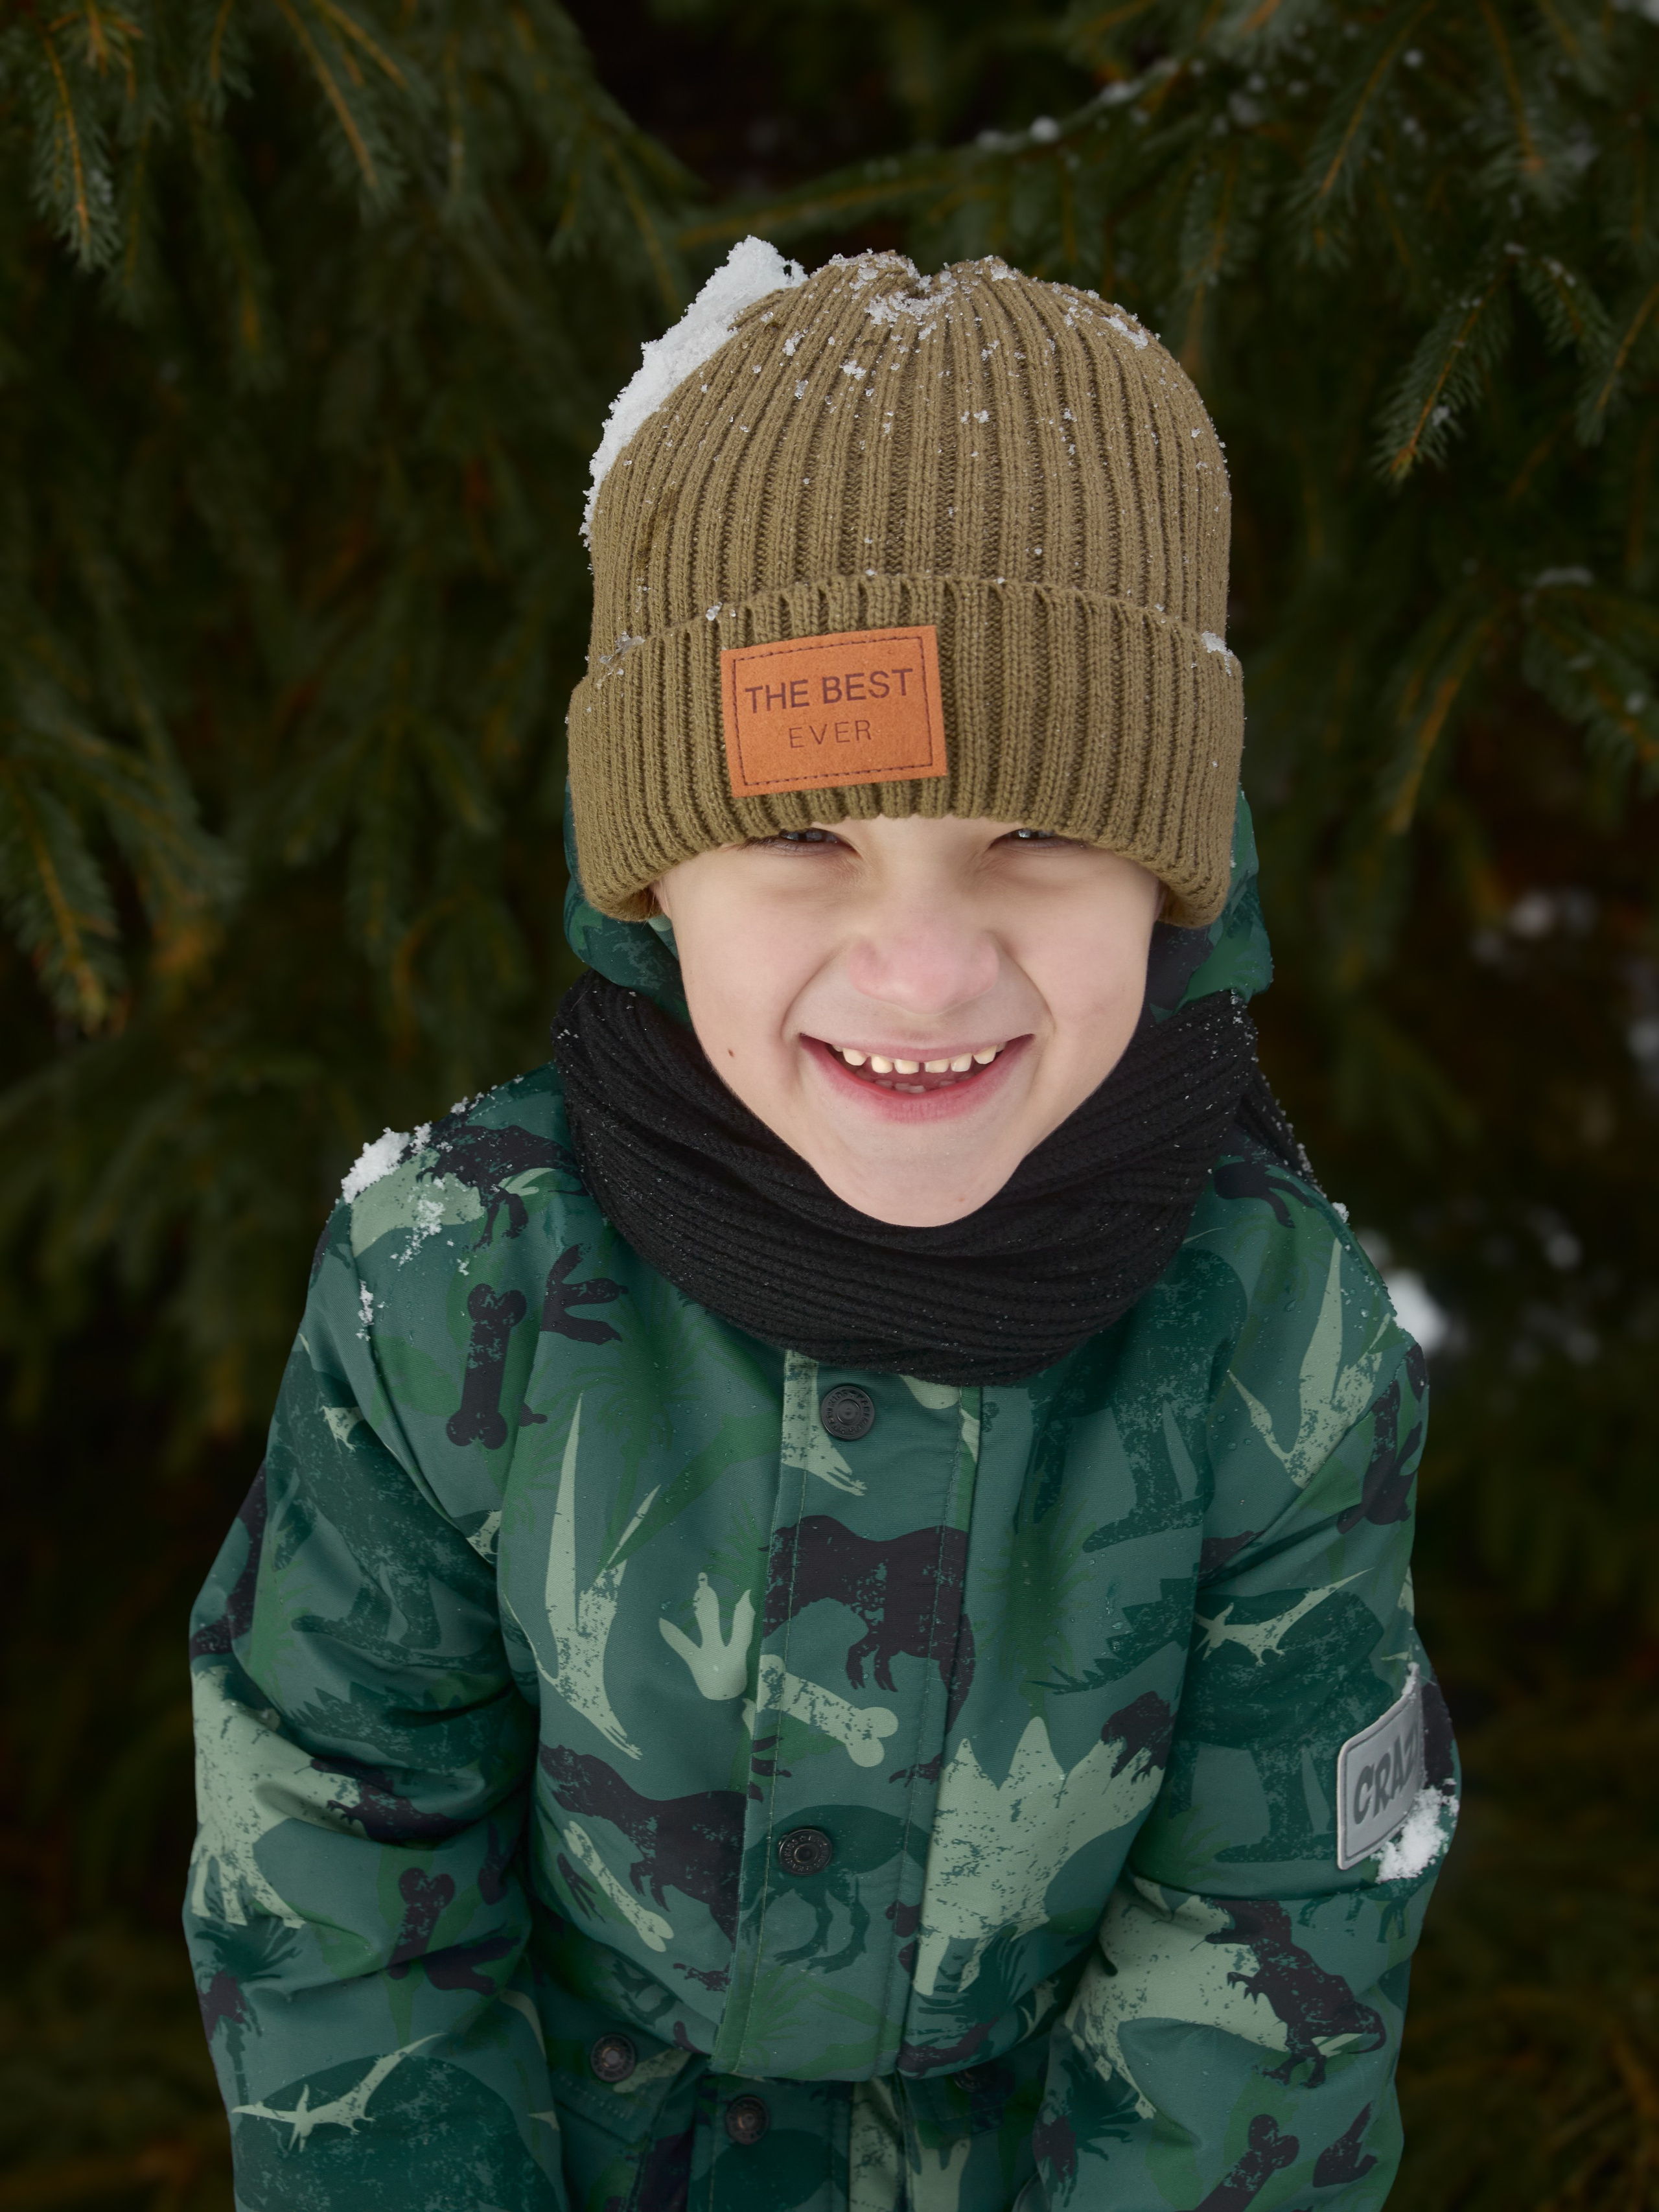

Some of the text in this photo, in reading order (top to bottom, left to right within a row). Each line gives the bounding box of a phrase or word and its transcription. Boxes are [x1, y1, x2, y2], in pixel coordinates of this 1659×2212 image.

[745, 668, 913, 714] THE BEST
[789, 719, 872, 749] EVER
